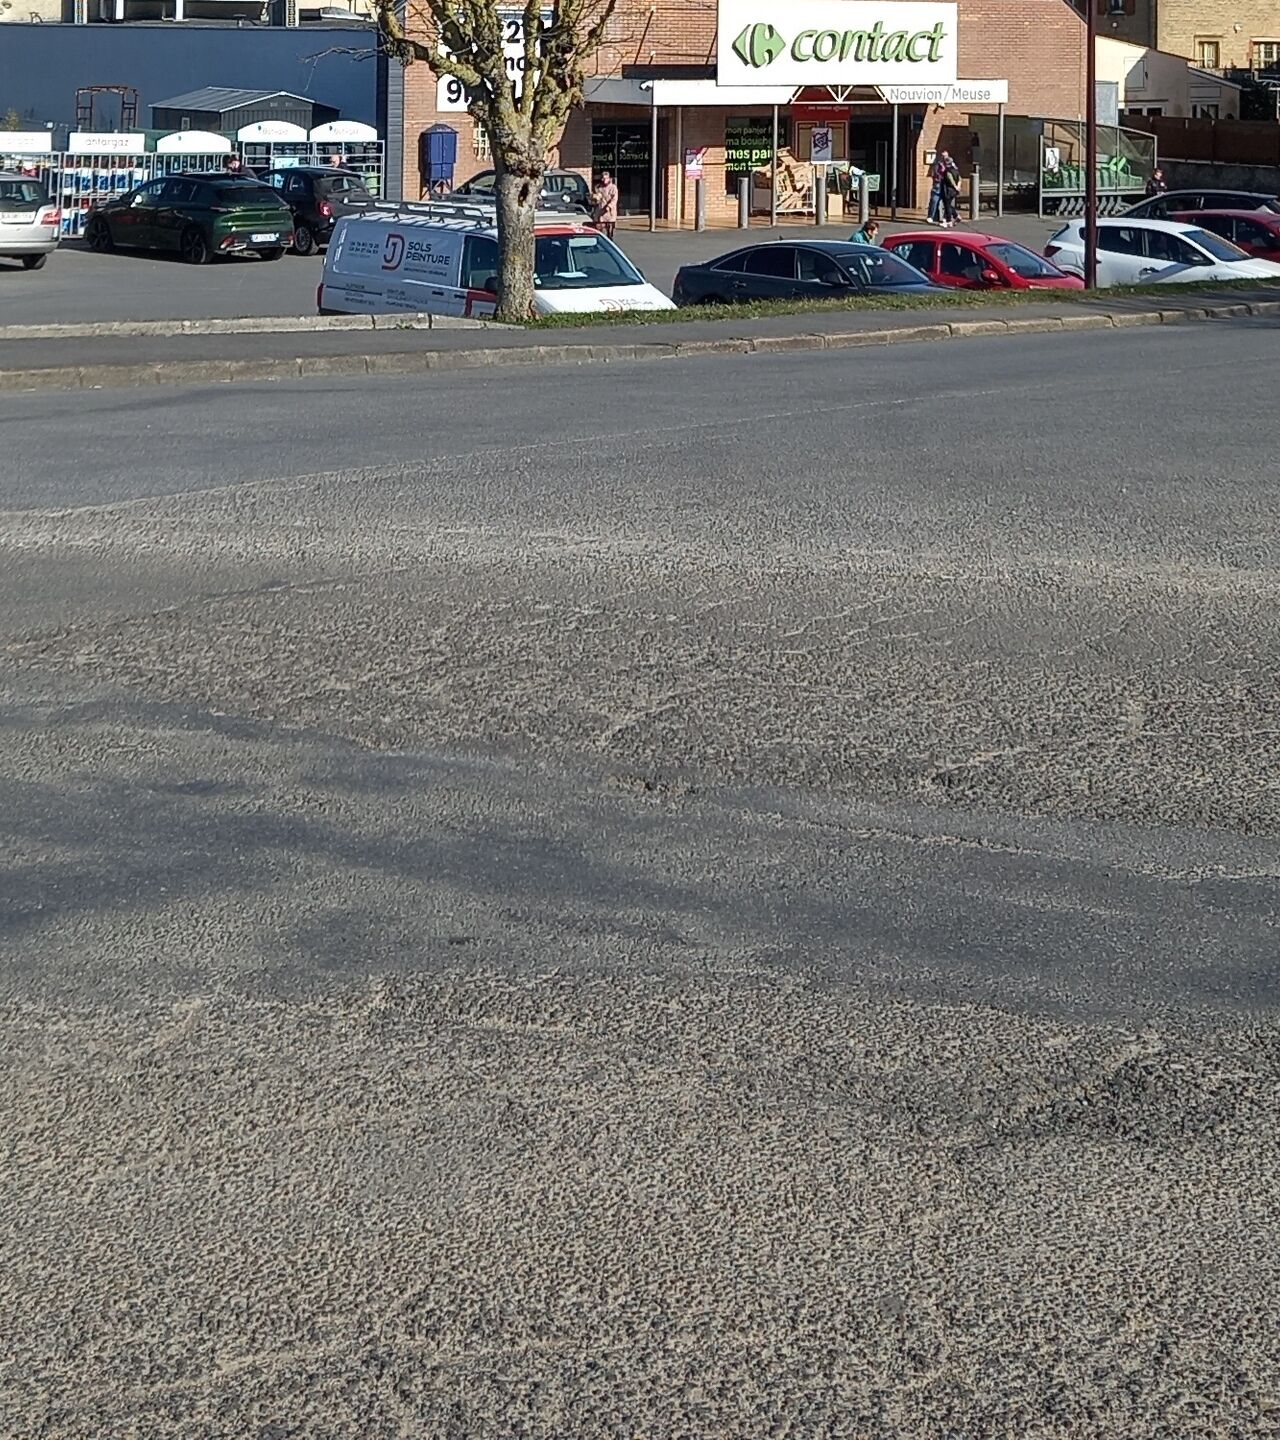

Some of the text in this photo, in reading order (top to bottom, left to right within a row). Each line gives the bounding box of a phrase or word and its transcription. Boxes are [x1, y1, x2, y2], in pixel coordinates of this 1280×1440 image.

[791, 21, 948, 62] contact
[85, 138, 129, 149] antargaz
[741, 136, 785, 146] bouche
[724, 149, 750, 160] mes
[407, 241, 432, 253] SOLS
